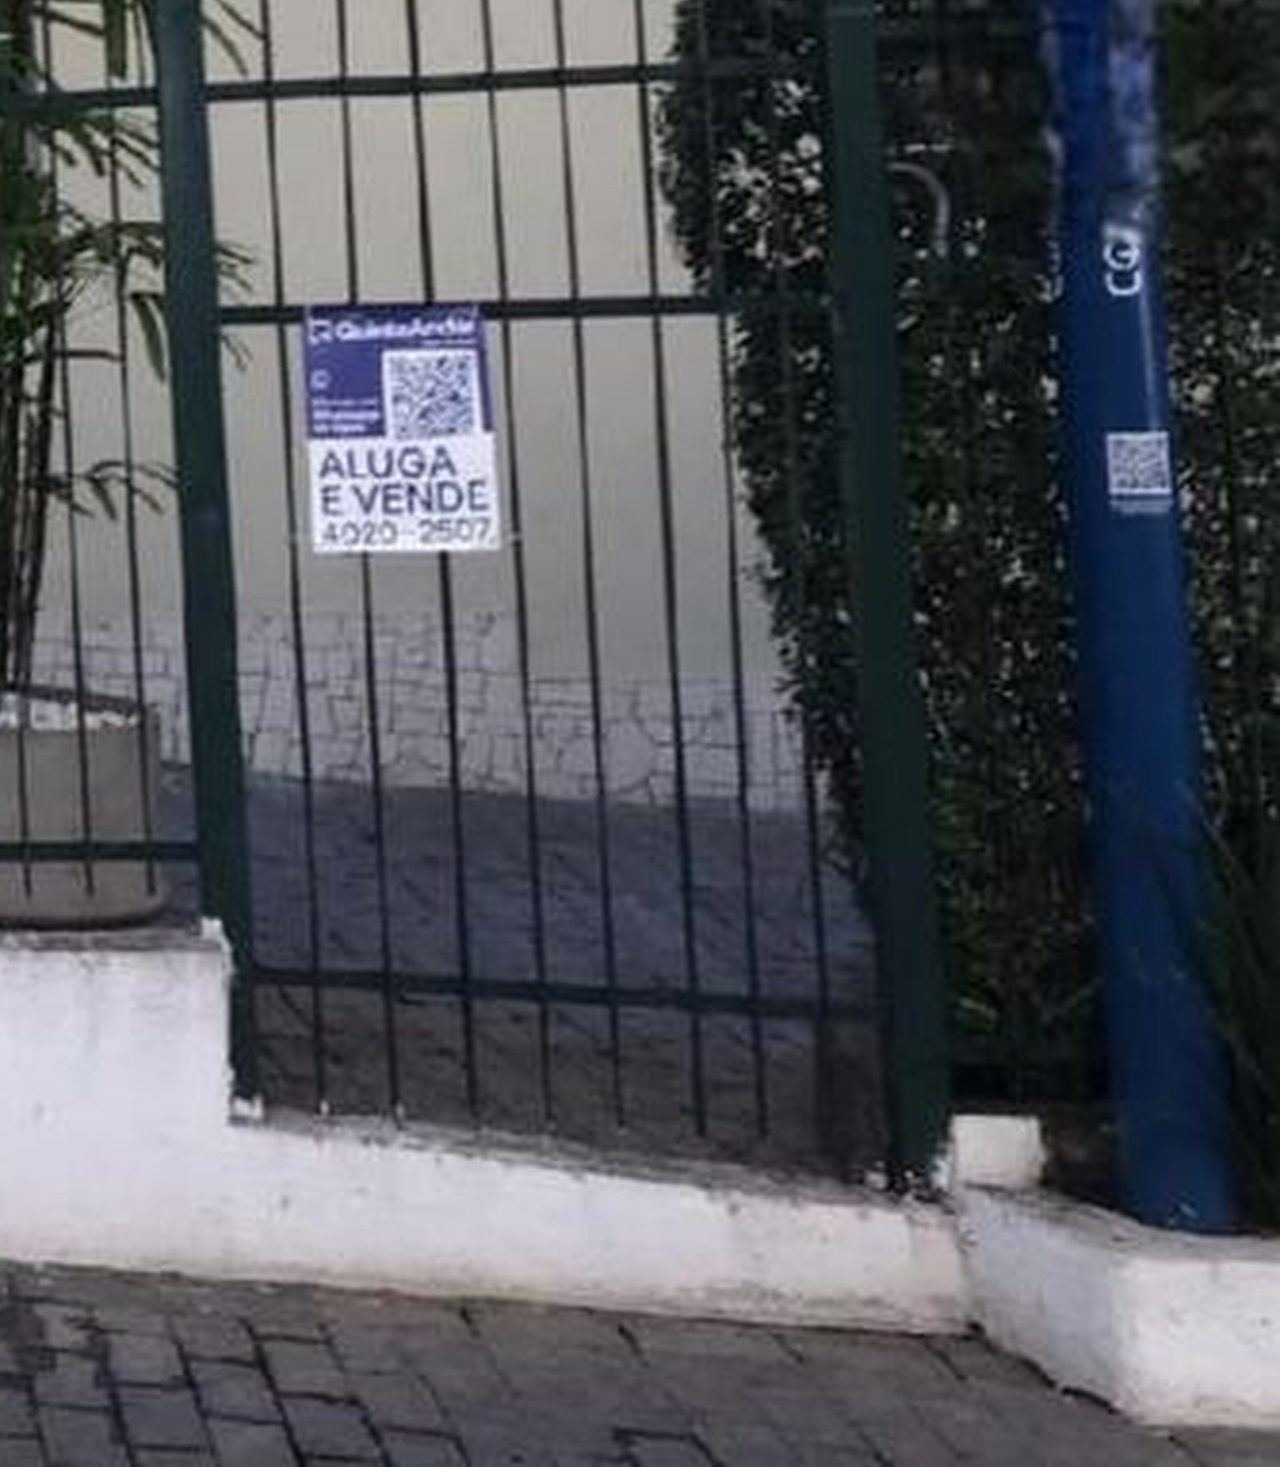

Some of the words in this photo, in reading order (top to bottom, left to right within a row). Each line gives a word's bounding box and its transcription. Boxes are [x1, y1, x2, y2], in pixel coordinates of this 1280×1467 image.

[319, 446, 457, 479] ALUGA
[320, 484, 342, 516] E
[352, 481, 489, 515] VENDE
